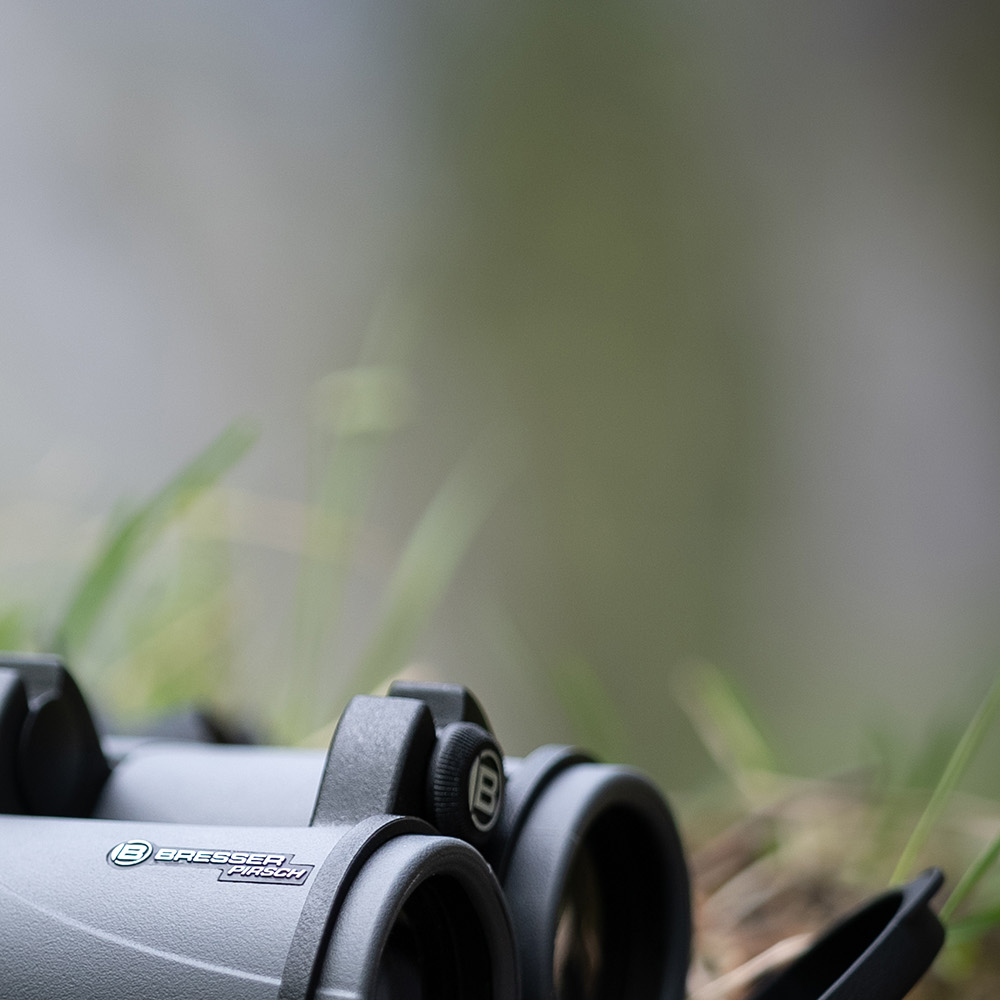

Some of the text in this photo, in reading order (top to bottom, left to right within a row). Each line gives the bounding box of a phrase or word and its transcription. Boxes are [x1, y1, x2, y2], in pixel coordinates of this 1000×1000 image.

[473, 763, 499, 816] B
[154, 847, 286, 867] BRESSER
[227, 866, 307, 880] PIRSCH
